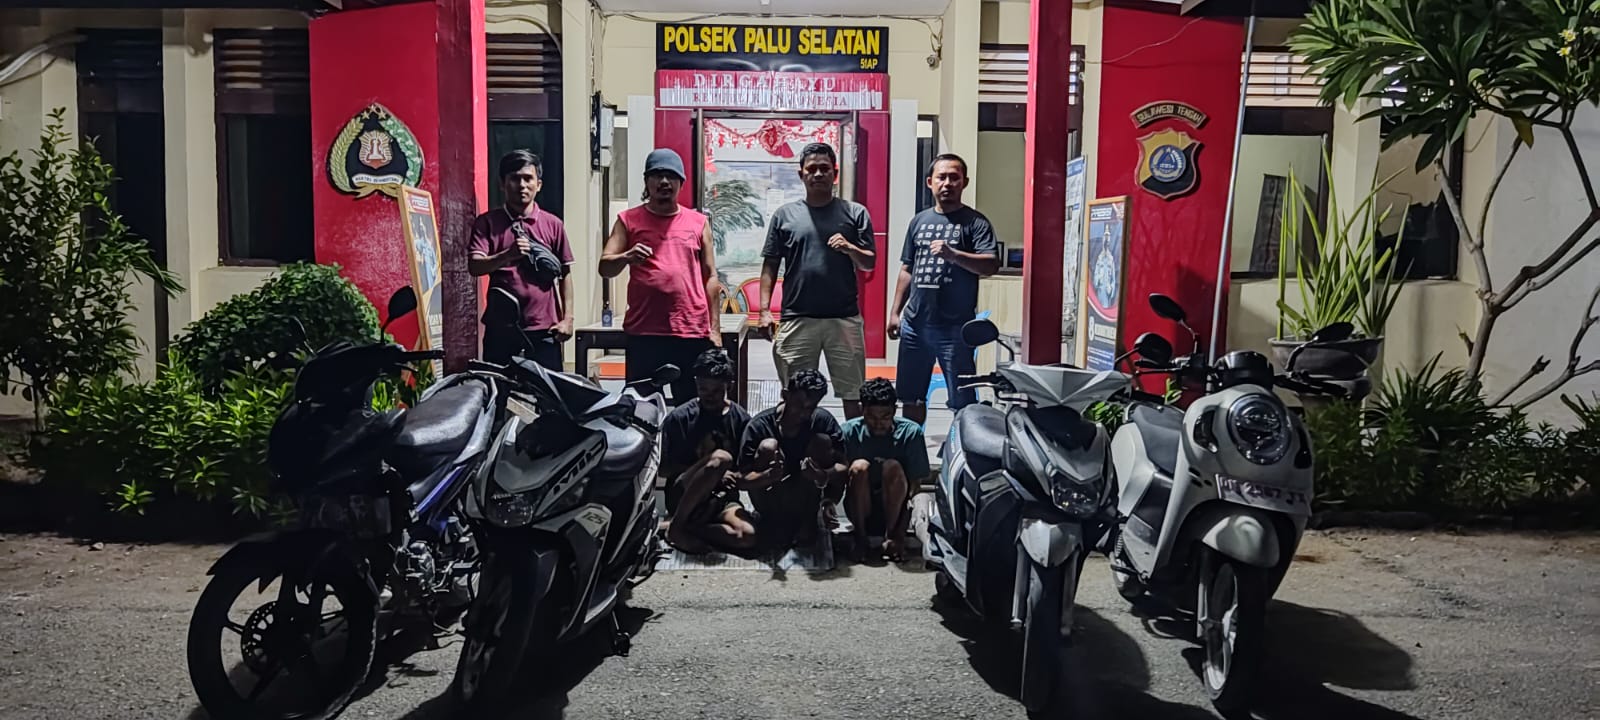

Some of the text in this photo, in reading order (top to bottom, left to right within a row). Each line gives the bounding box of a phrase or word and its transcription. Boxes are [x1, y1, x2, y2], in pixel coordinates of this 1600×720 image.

[663, 26, 880, 56] POLSEK PALU SELATAN
[581, 511, 607, 525] 125
